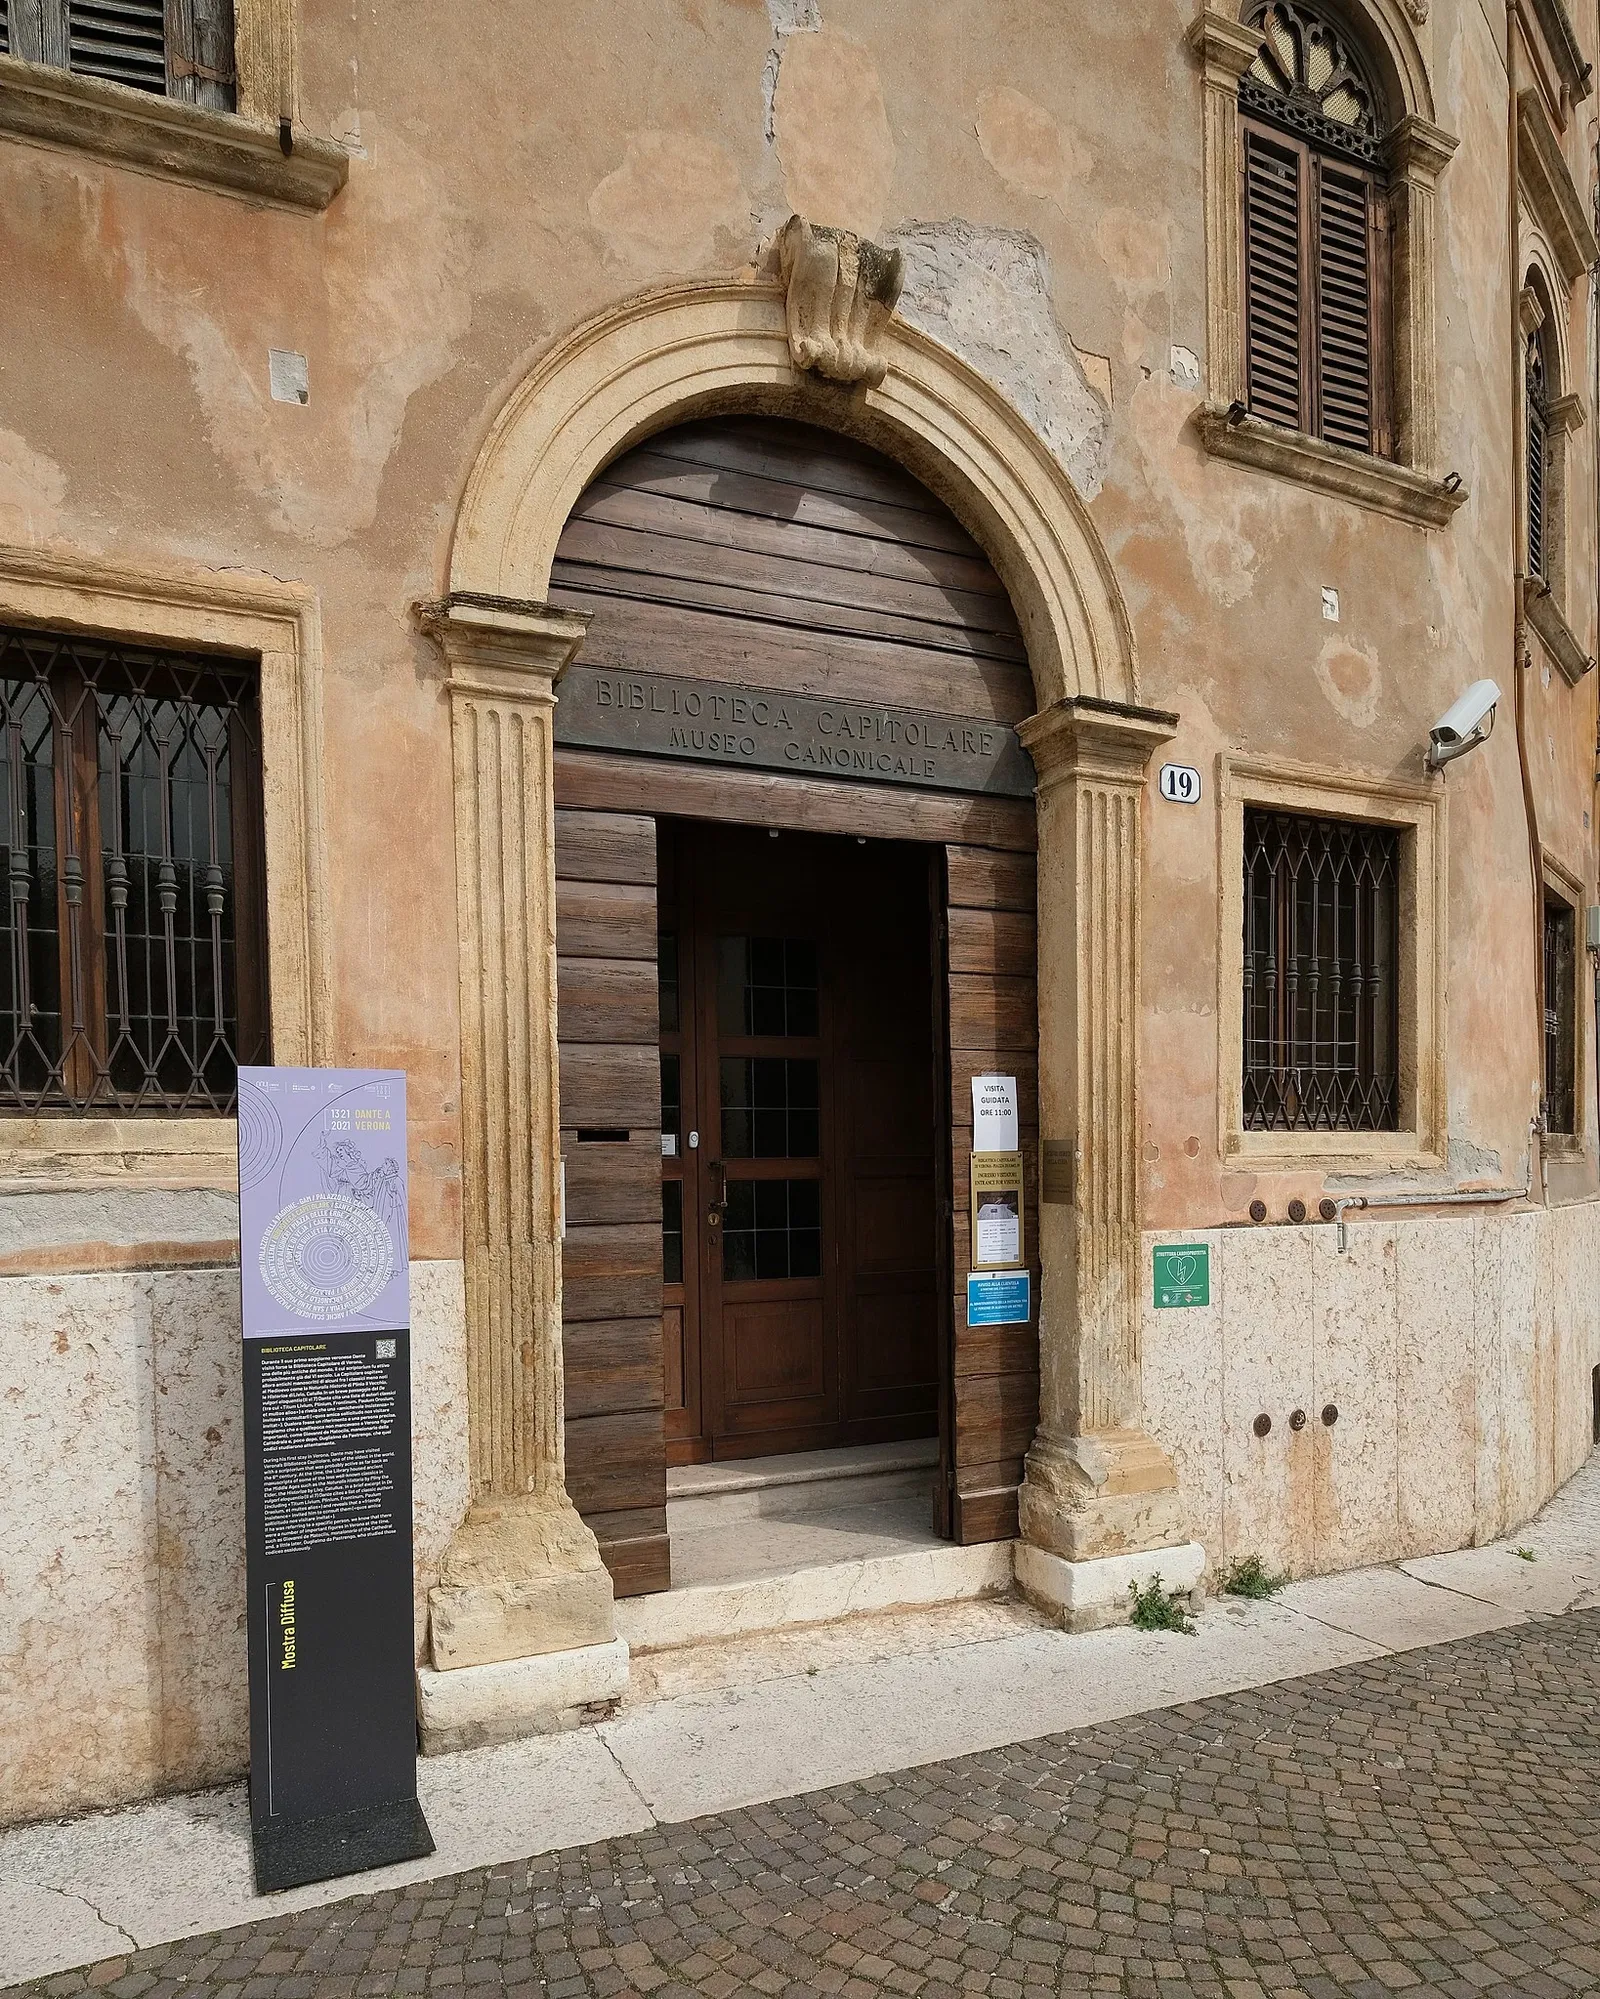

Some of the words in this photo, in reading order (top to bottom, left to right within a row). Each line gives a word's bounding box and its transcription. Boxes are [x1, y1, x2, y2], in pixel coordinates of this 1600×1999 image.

[596, 679, 793, 730] BIBLIOTECA
[817, 711, 994, 756] CAPITOLARE
[669, 727, 757, 756] MUSEO
[784, 742, 937, 778] CANONICALE
[1166, 769, 1192, 797] 19
[331, 1109, 350, 1118] 1321
[355, 1109, 382, 1118] DANTE
[385, 1110, 390, 1118] A
[332, 1121, 350, 1130] 2021
[355, 1121, 390, 1130] VERONA
[279, 1580, 295, 1625] Diffusa
[281, 1628, 296, 1670] Mostra
